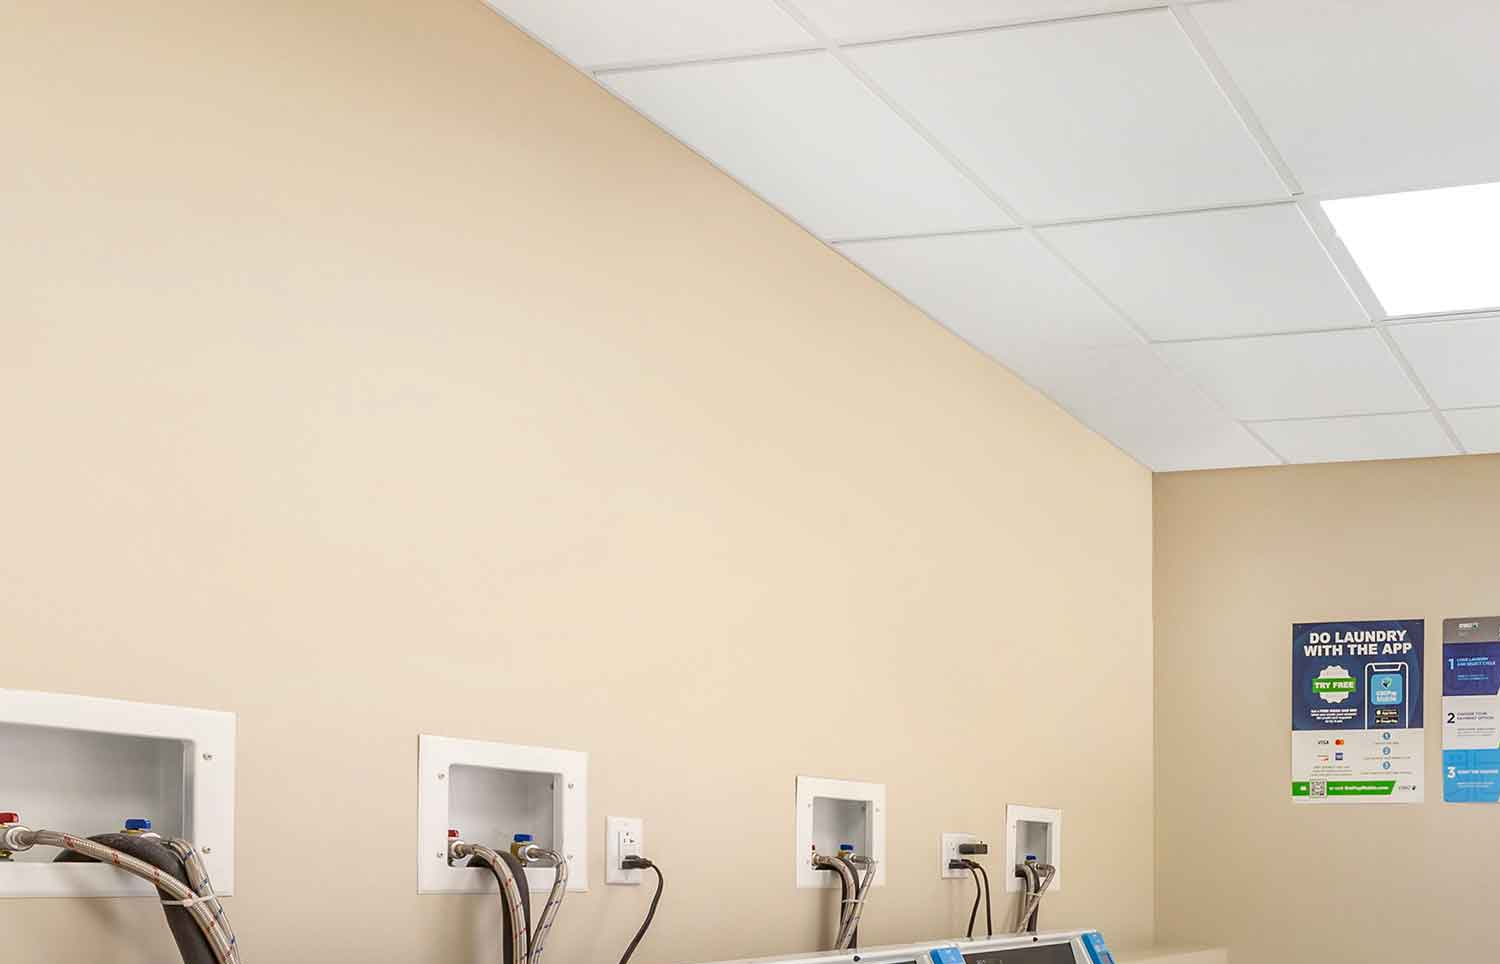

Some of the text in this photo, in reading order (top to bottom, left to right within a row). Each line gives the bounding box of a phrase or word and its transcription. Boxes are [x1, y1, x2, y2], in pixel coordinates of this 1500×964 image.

[1309, 630, 1407, 644] DO LAUNDRY
[1303, 642, 1412, 657] WITH THE APP
[1448, 658, 1454, 670] 1
[1332, 681, 1354, 689] FREE
[1447, 712, 1456, 724] 2
[1447, 766, 1456, 779] 3
